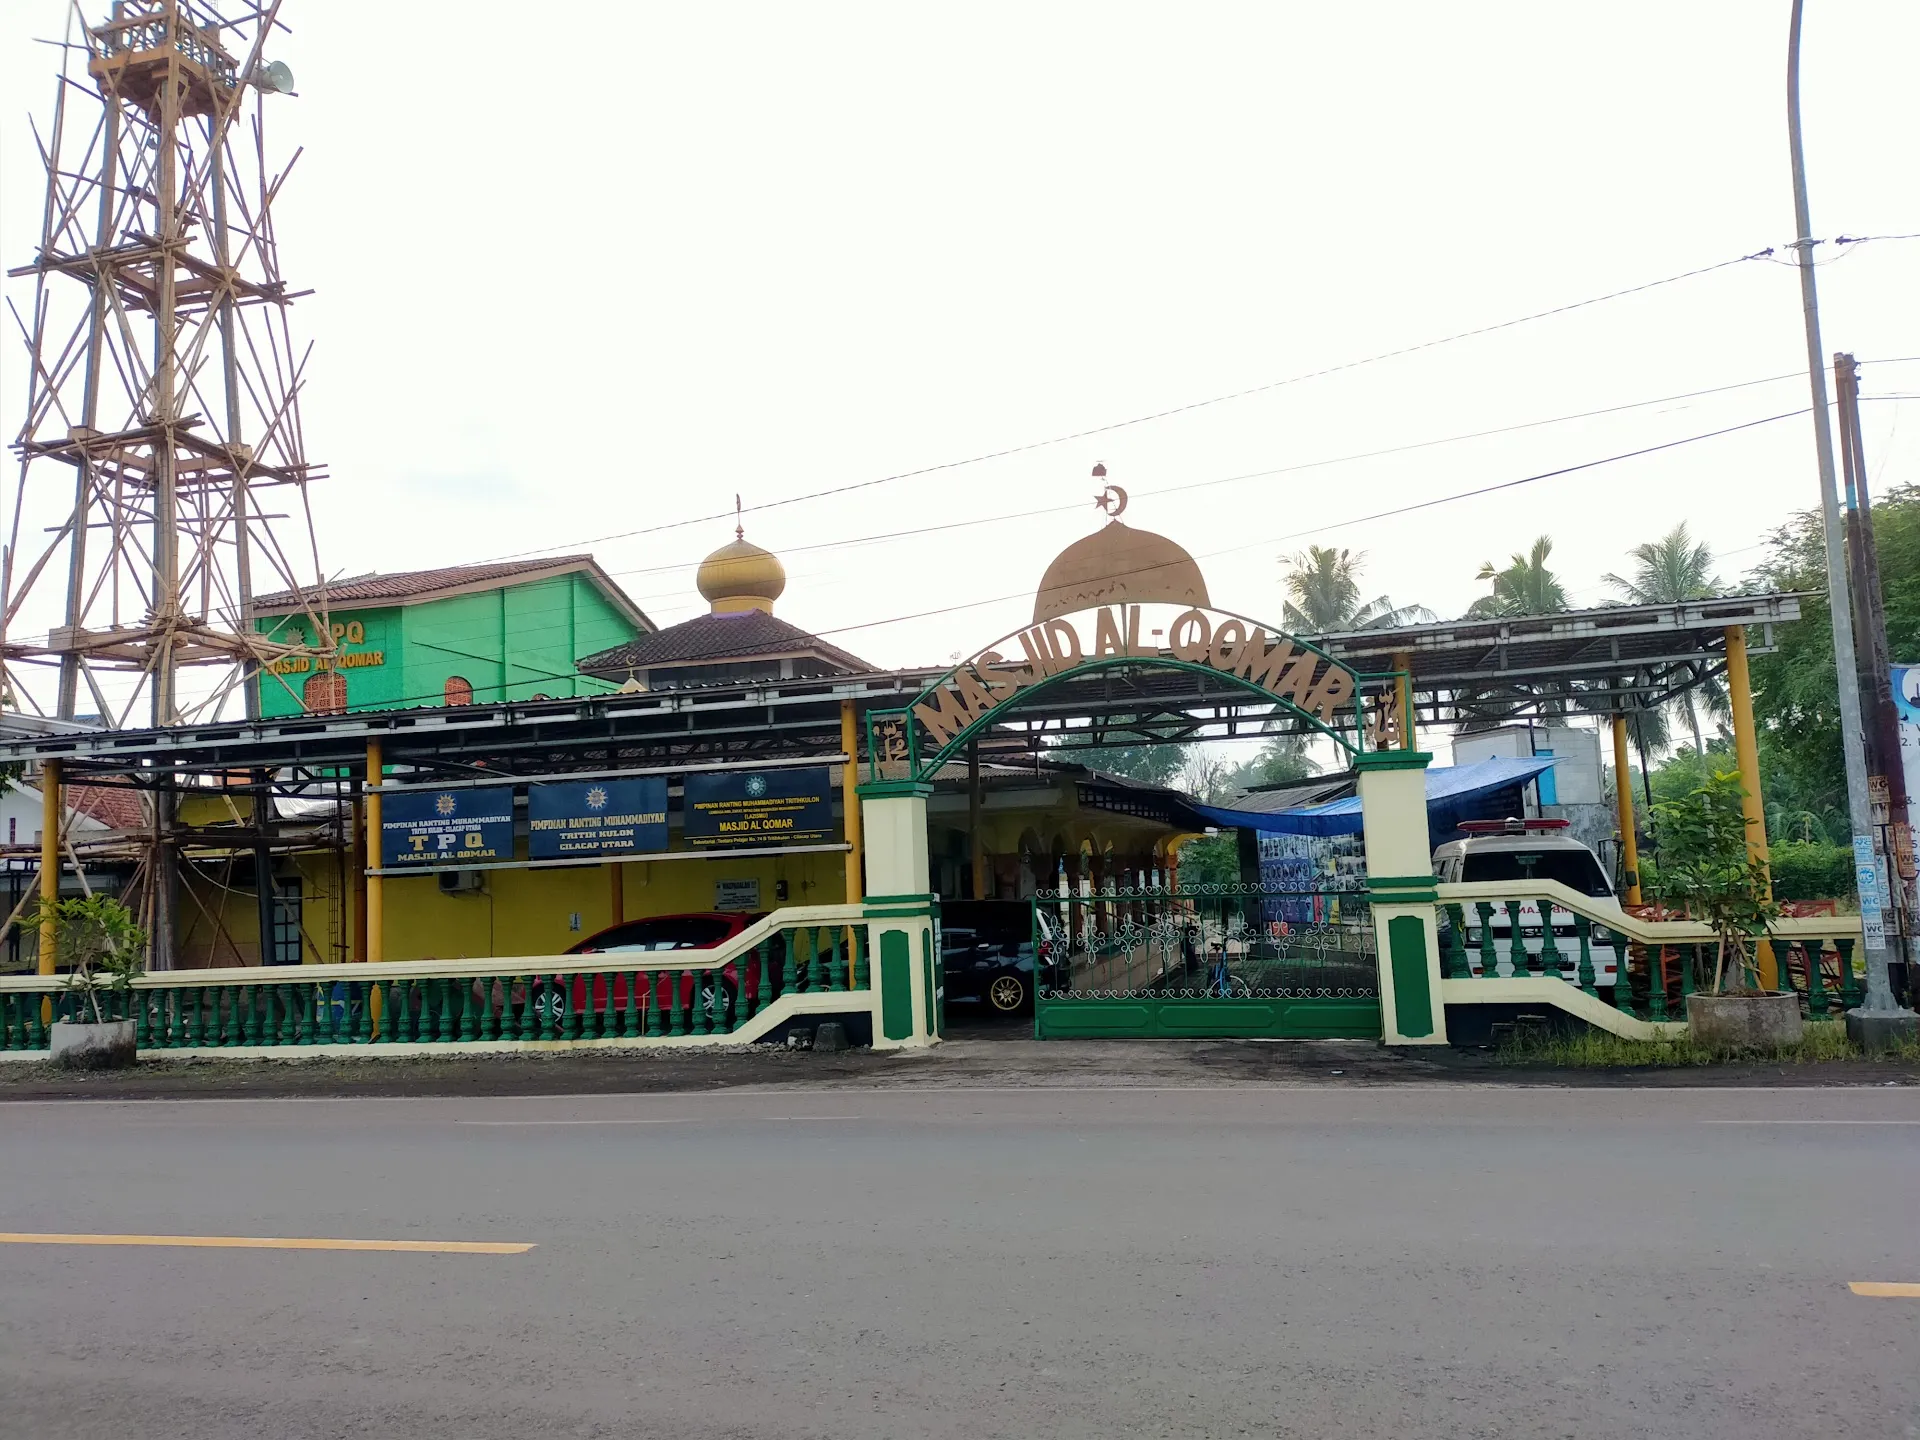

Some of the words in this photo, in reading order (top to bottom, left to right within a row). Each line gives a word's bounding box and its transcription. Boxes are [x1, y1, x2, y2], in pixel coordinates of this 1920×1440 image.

[331, 621, 364, 645] PQ
[912, 616, 1084, 747] MASJID
[1095, 604, 1354, 724] AL-QOMAR
[1901, 737, 1912, 747] 2.
[742, 798, 784, 806] MUHAMMADIYAH
[451, 816, 511, 826] MUHAMMADIYAH
[531, 819, 567, 830] PIMPINAN
[569, 817, 601, 828] RANTING
[604, 813, 665, 826] MUHAMMADIYAH
[720, 822, 749, 832] MASJID
[750, 820, 761, 830] AL
[762, 819, 793, 828] QOMAR
[560, 830, 596, 840] TRITIH
[599, 829, 634, 838] KULON
[408, 835, 428, 851] T
[437, 834, 456, 850] P
[465, 832, 484, 848] Q
[560, 842, 599, 850] CILACAP
[602, 840, 634, 848] UTARA
[398, 852, 437, 861] MASJID
[457, 849, 496, 858] QOMAR
